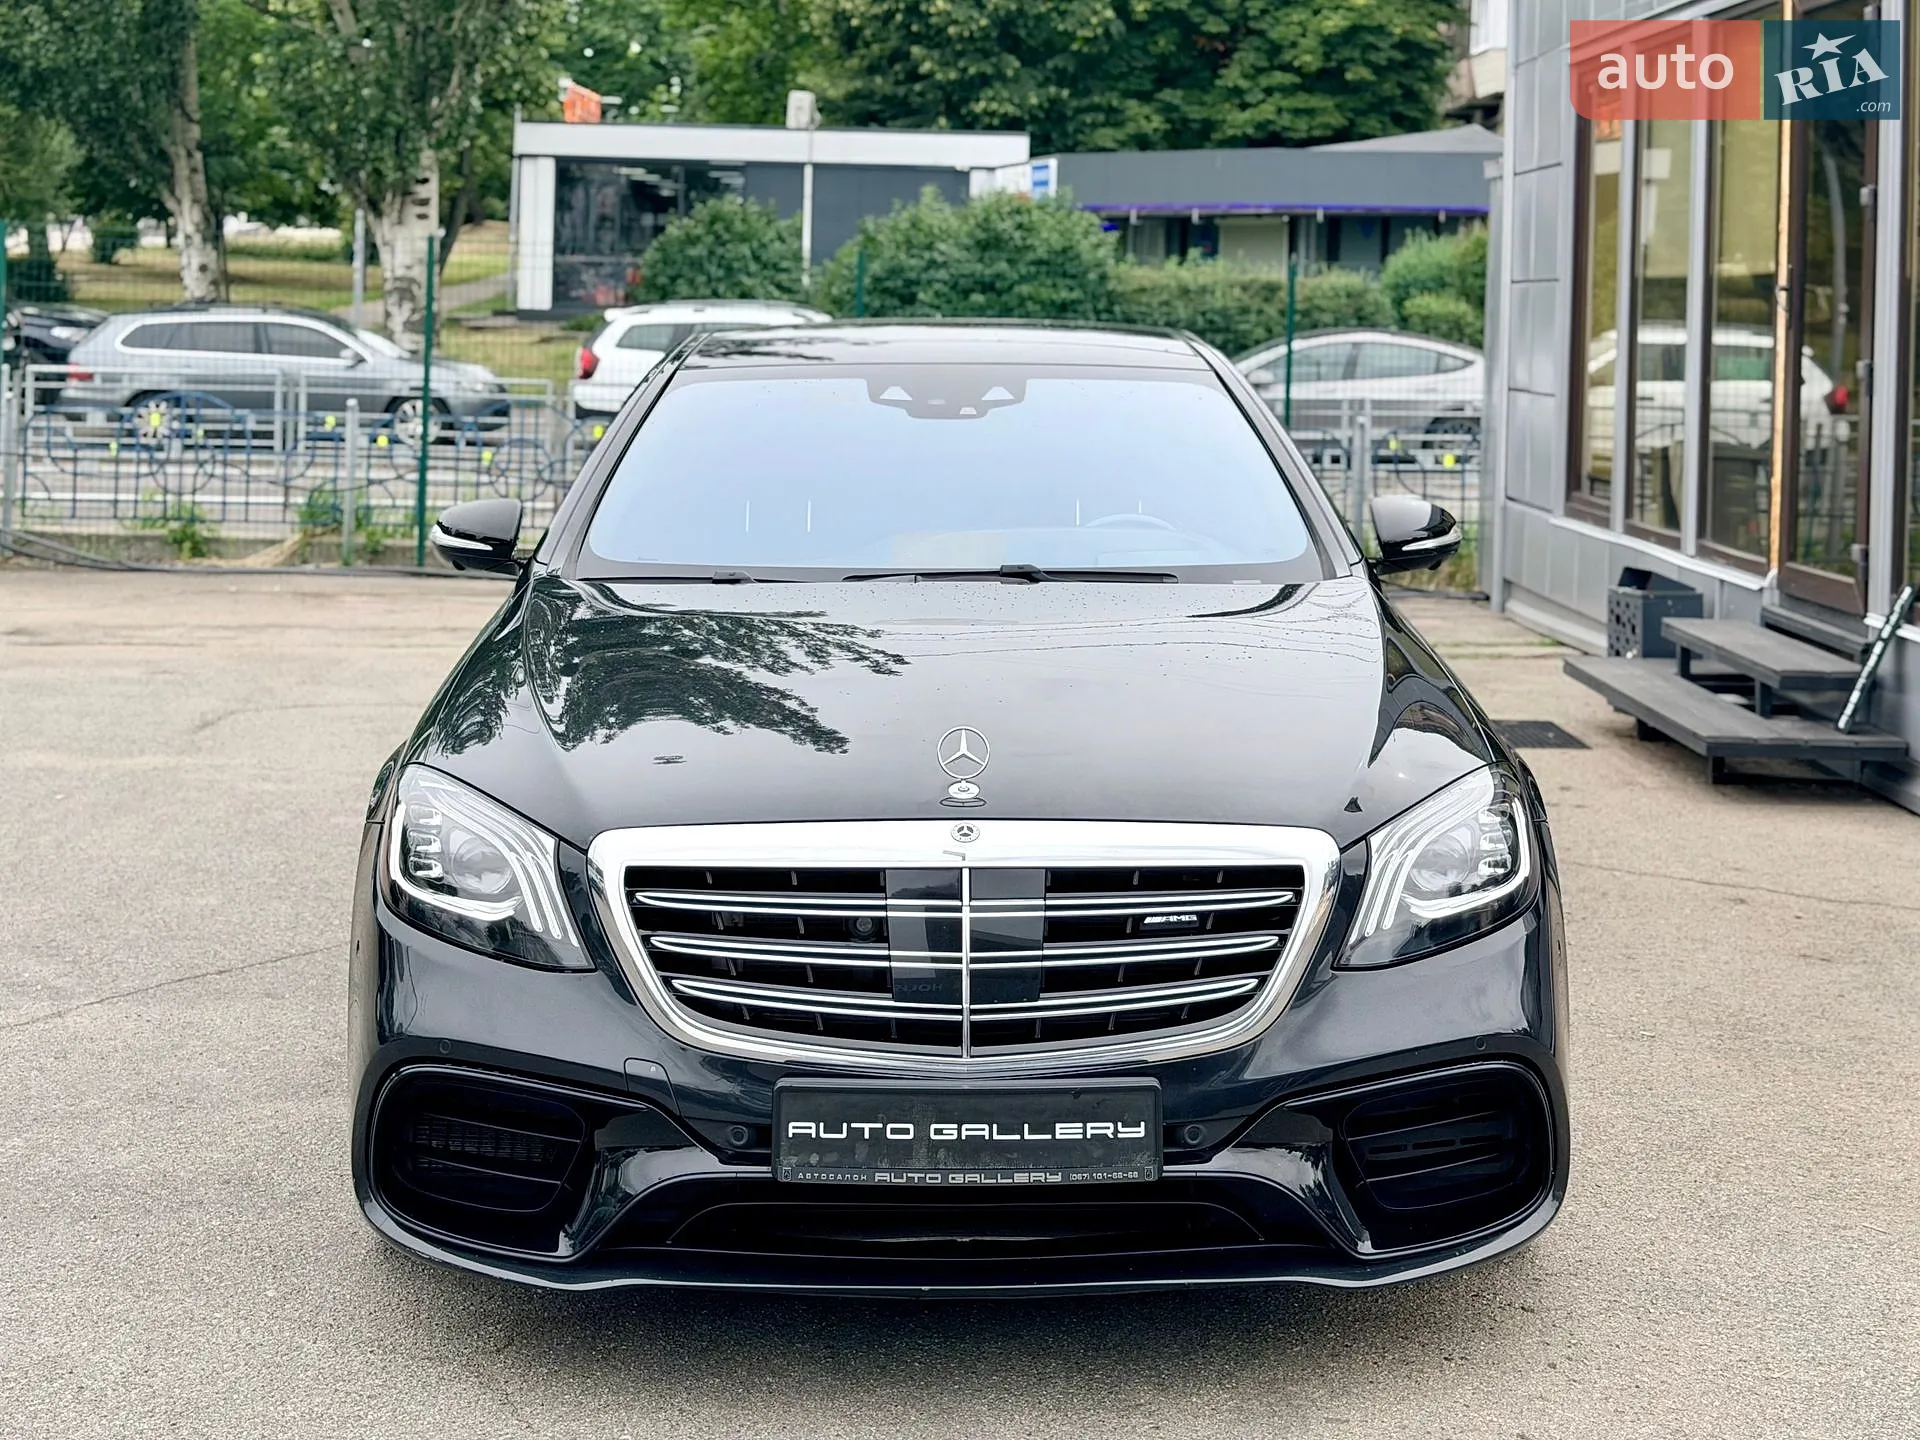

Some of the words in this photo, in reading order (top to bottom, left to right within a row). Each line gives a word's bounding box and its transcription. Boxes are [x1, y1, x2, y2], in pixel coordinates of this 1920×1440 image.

[788, 1121, 914, 1139] AUTO
[930, 1121, 1145, 1140] GALLERY
[874, 1172, 942, 1184] AUTO
[948, 1172, 1062, 1184] GALLERY
